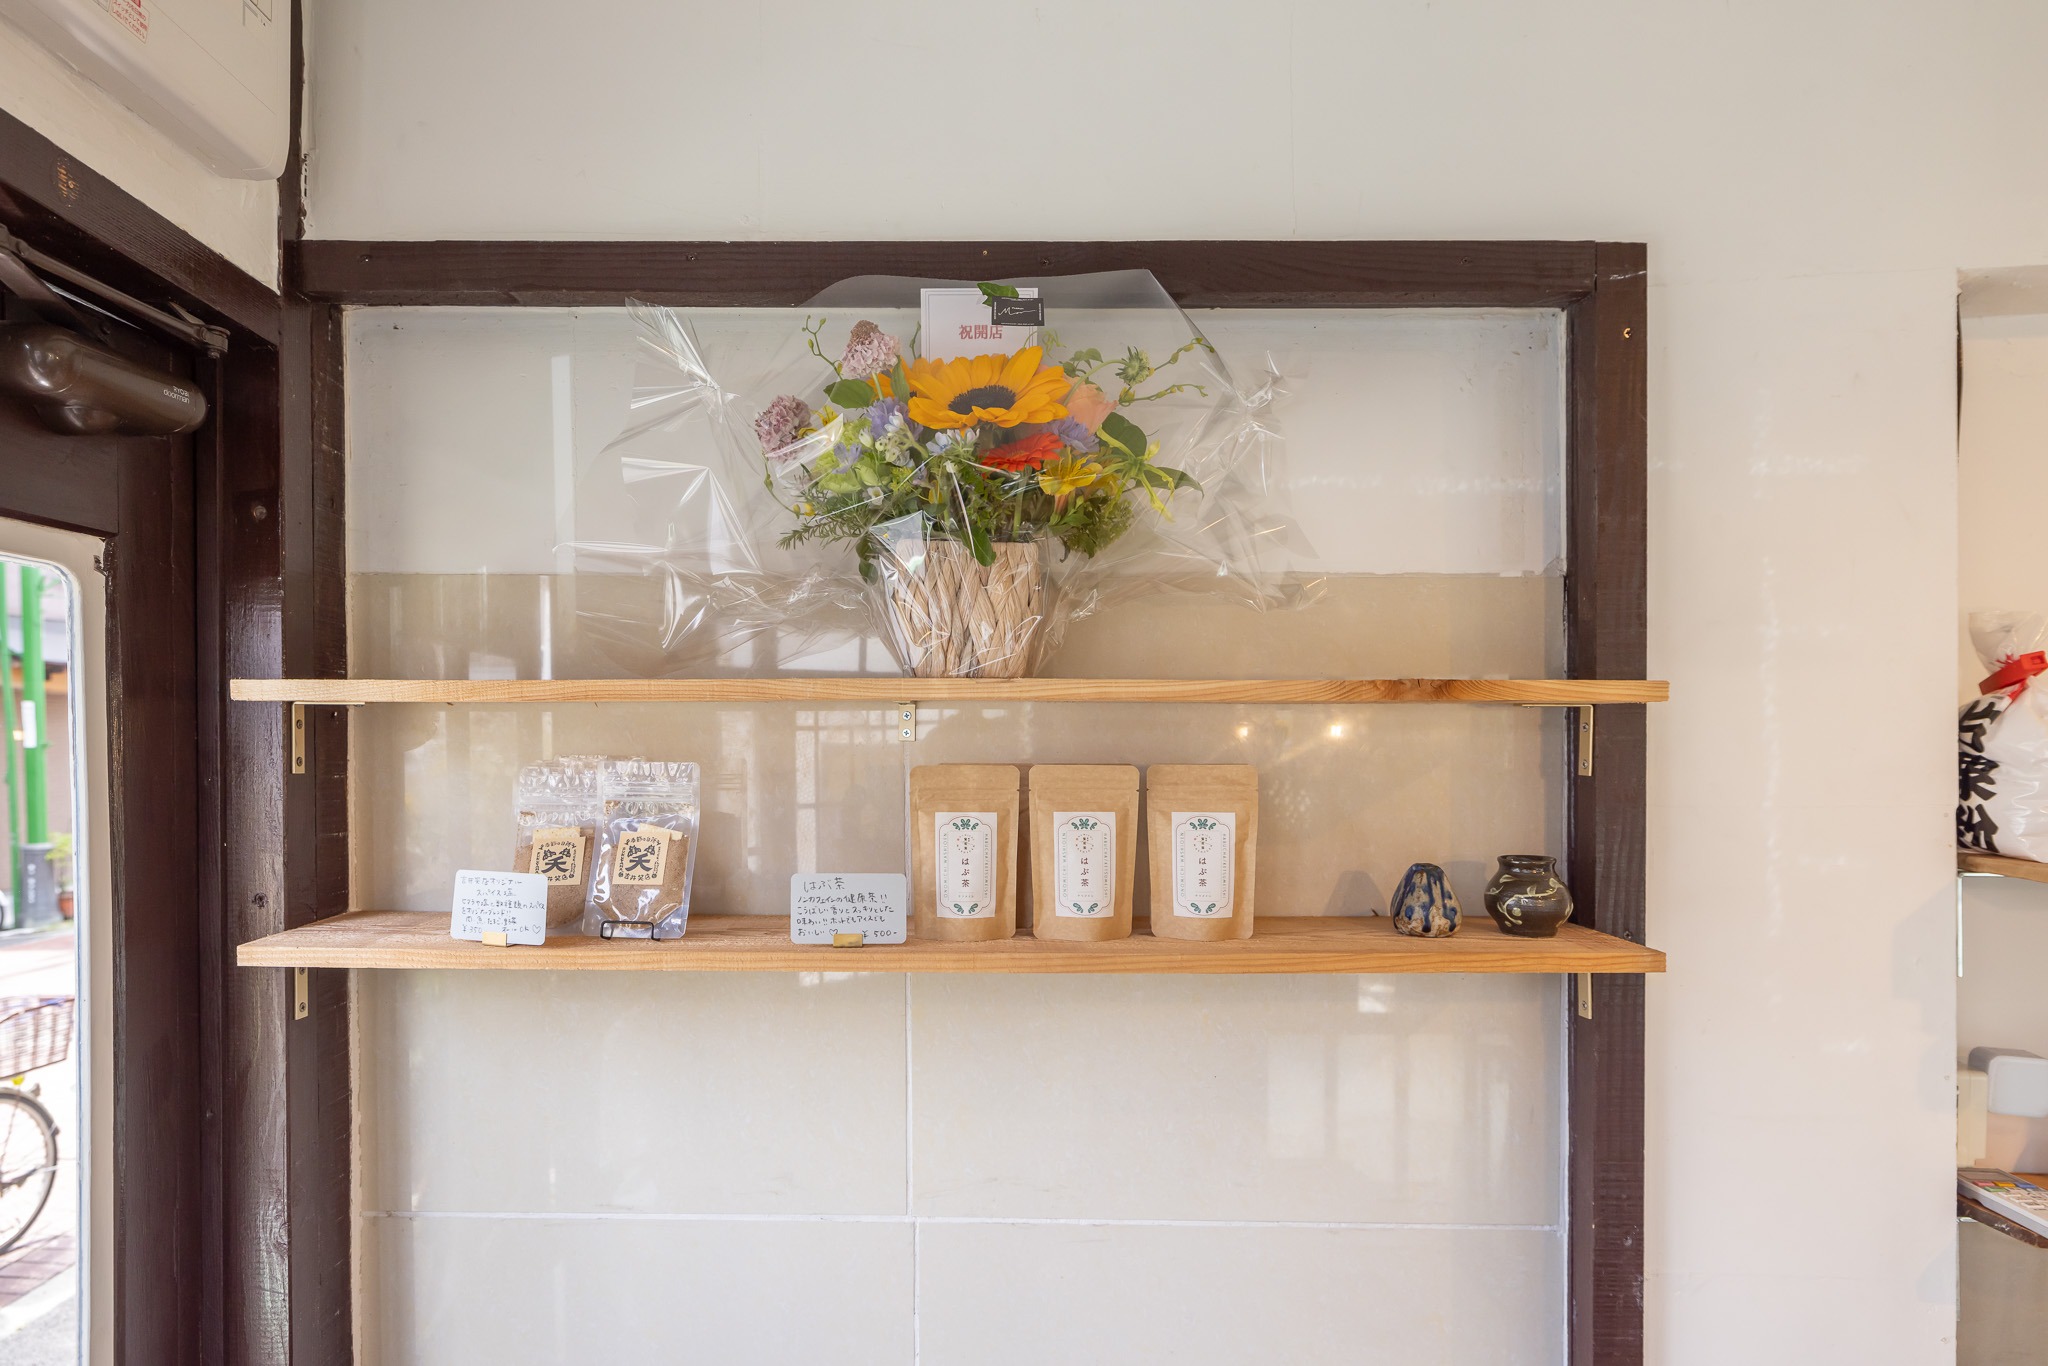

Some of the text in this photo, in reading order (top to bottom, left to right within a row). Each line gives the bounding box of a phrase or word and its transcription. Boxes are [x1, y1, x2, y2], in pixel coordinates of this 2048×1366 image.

[959, 324, 1003, 340] 祝開店
[163, 389, 190, 404] doorman
[625, 845, 655, 872] 笑
[1080, 857, 1089, 887] はぶ茶
[1198, 857, 1208, 887] はぶ茶
[803, 877, 845, 893] はぶ茶
[961, 858, 970, 888] はぶ茶
